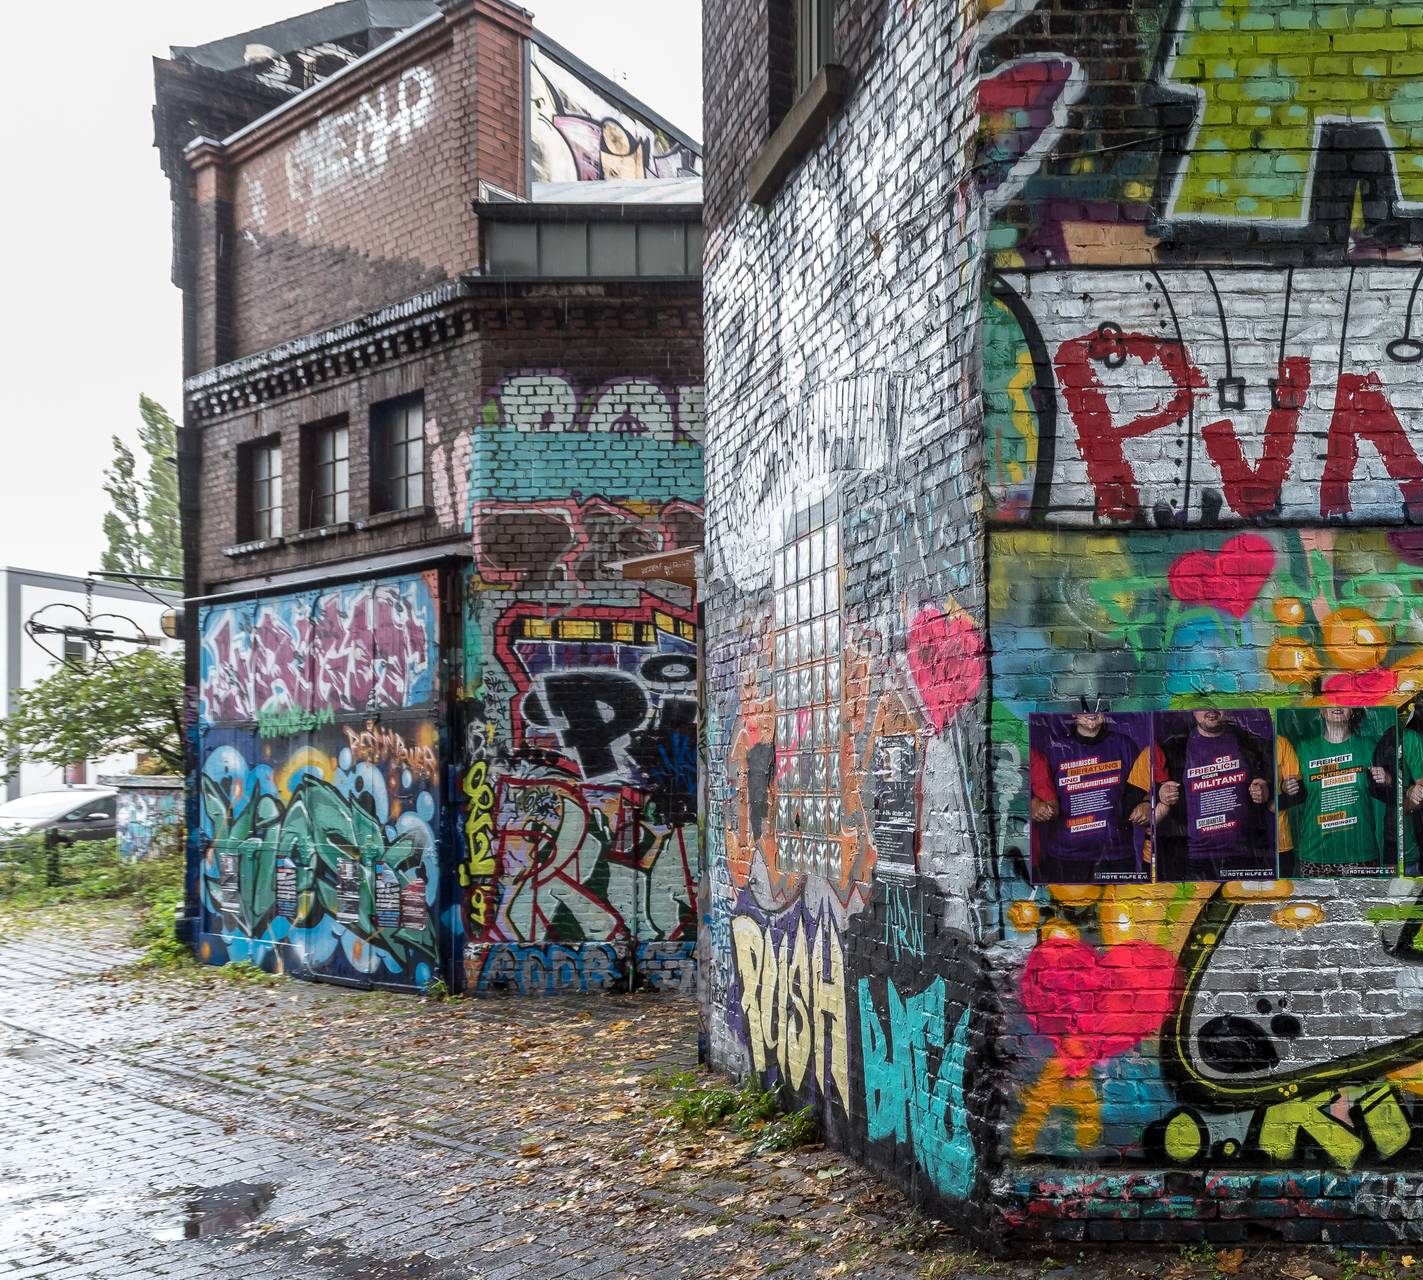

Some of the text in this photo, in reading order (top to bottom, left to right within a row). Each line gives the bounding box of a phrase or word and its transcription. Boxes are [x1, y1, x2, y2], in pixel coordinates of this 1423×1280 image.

[1215, 755, 1231, 764] OB
[1310, 754, 1351, 768] FREIHEIT
[1069, 762, 1119, 777] BERATUNG
[1189, 761, 1237, 777] FRIEDLICH
[1060, 776, 1079, 786] UND
[1193, 773, 1245, 790] MILITANT
[1202, 821, 1236, 832] VERBINDET
[1323, 818, 1356, 828] VERBINDET
